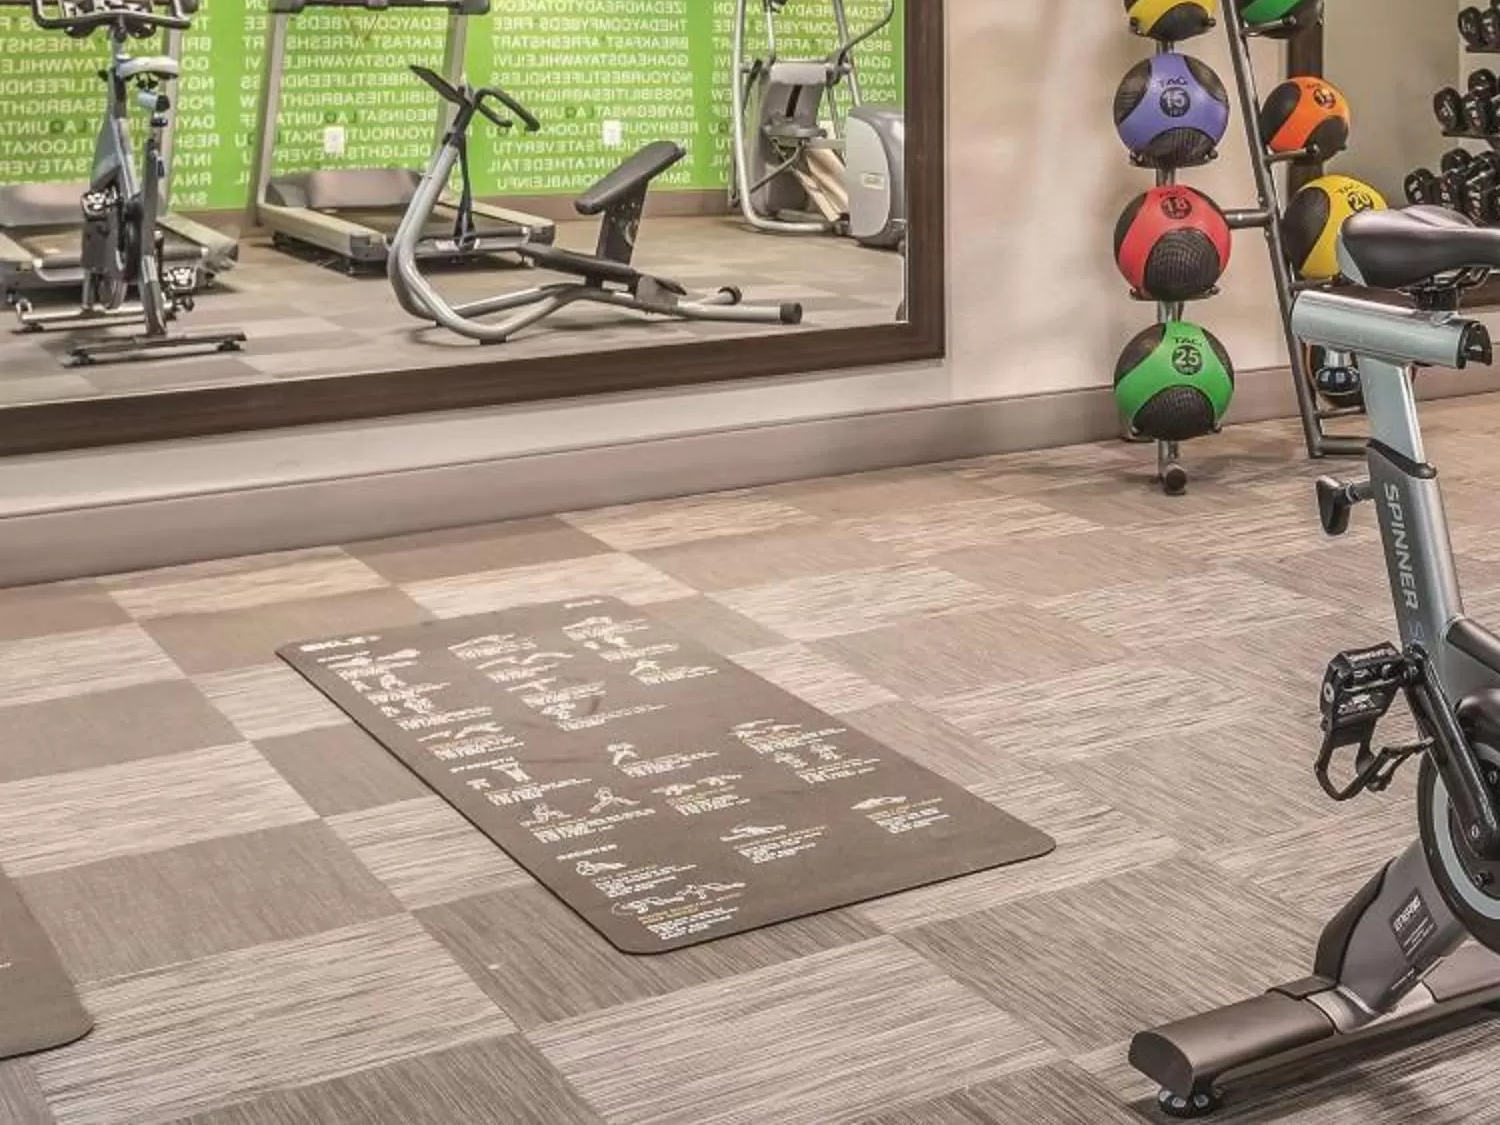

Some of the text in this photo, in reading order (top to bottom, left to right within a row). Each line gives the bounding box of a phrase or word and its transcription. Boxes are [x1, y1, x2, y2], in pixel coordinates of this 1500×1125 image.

[1162, 89, 1186, 108] 15
[1174, 348, 1200, 367] 25
[1383, 481, 1420, 610] SPINNER
